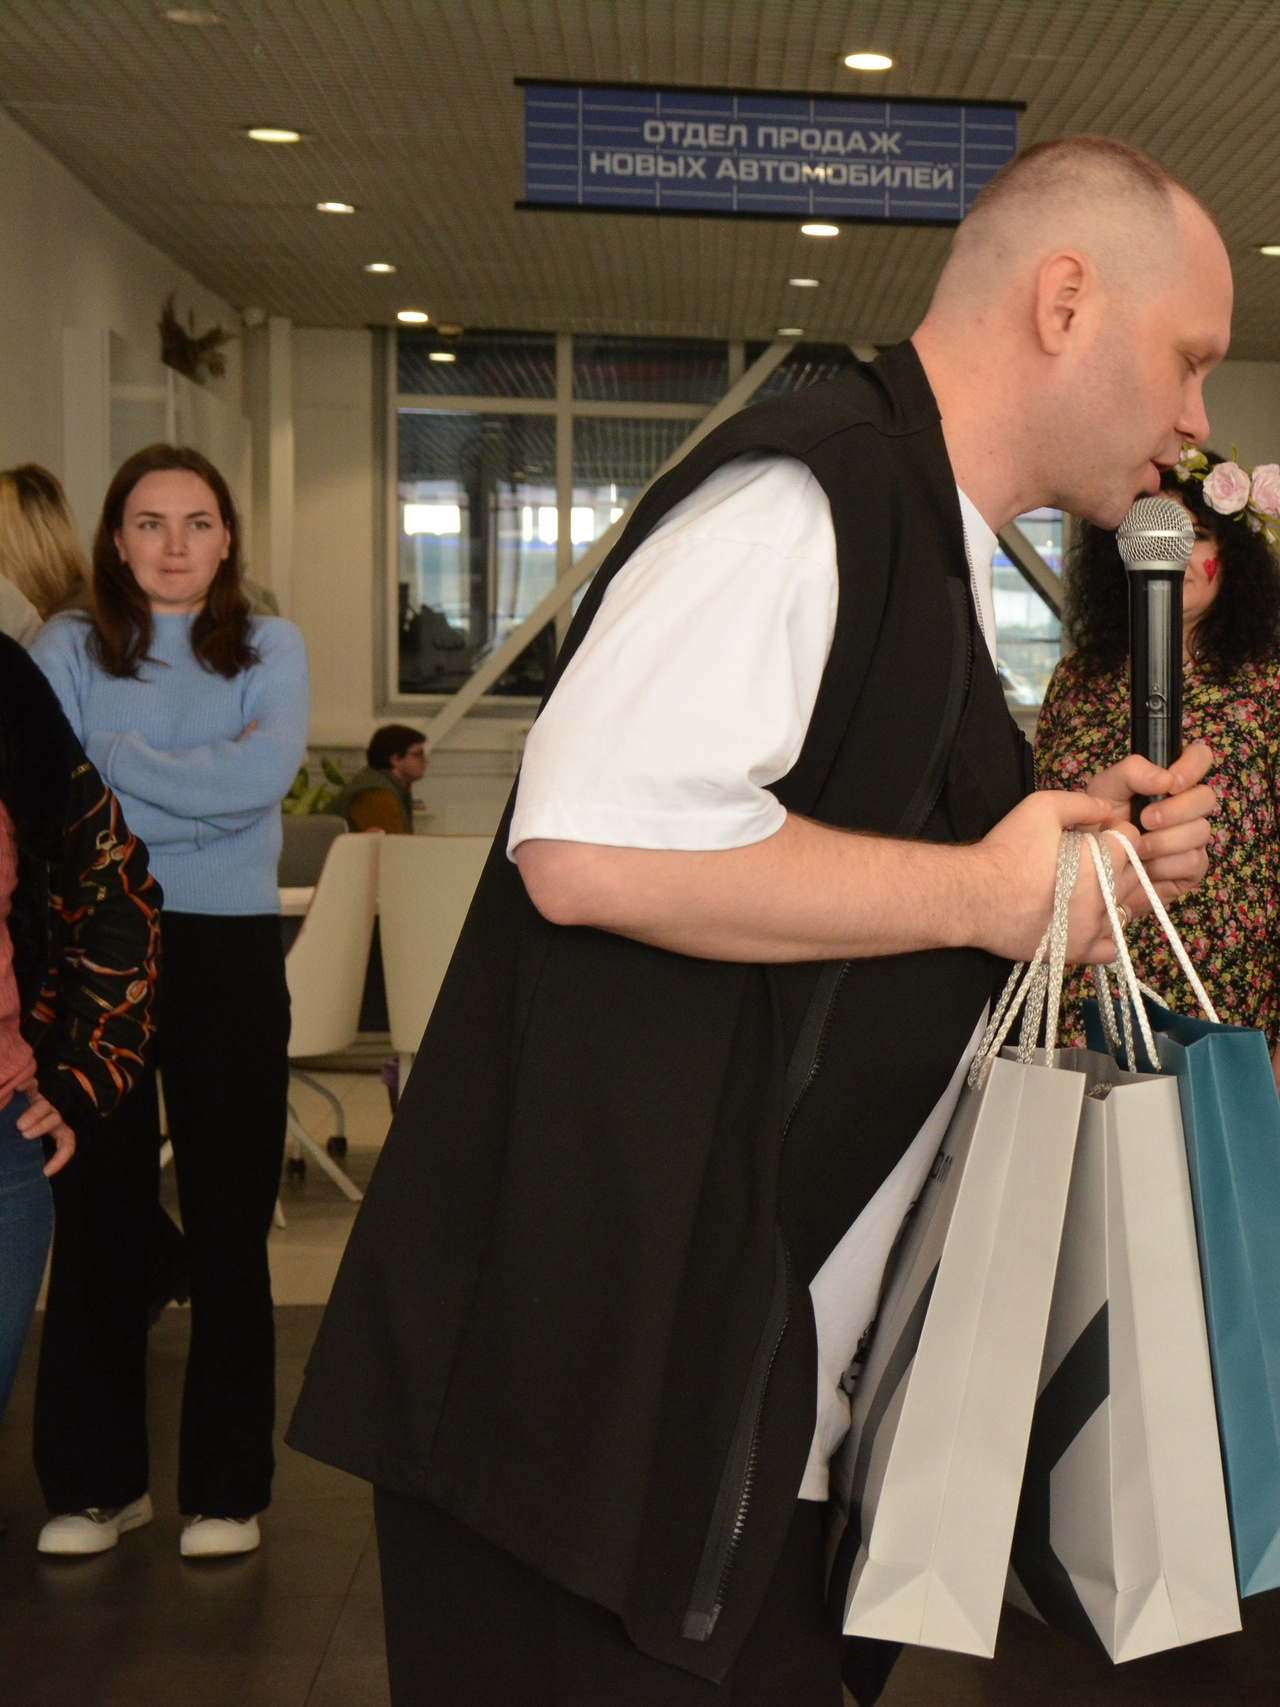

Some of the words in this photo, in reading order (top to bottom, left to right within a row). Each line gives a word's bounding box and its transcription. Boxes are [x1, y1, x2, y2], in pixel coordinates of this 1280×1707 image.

[643, 120, 749, 149] ОТДЕЛ
[757, 126, 902, 155] ПРОДАЖ
[589, 151, 707, 180] НОВЫХ
[716, 157, 954, 190] АВТОМОБИЛЕЙ
